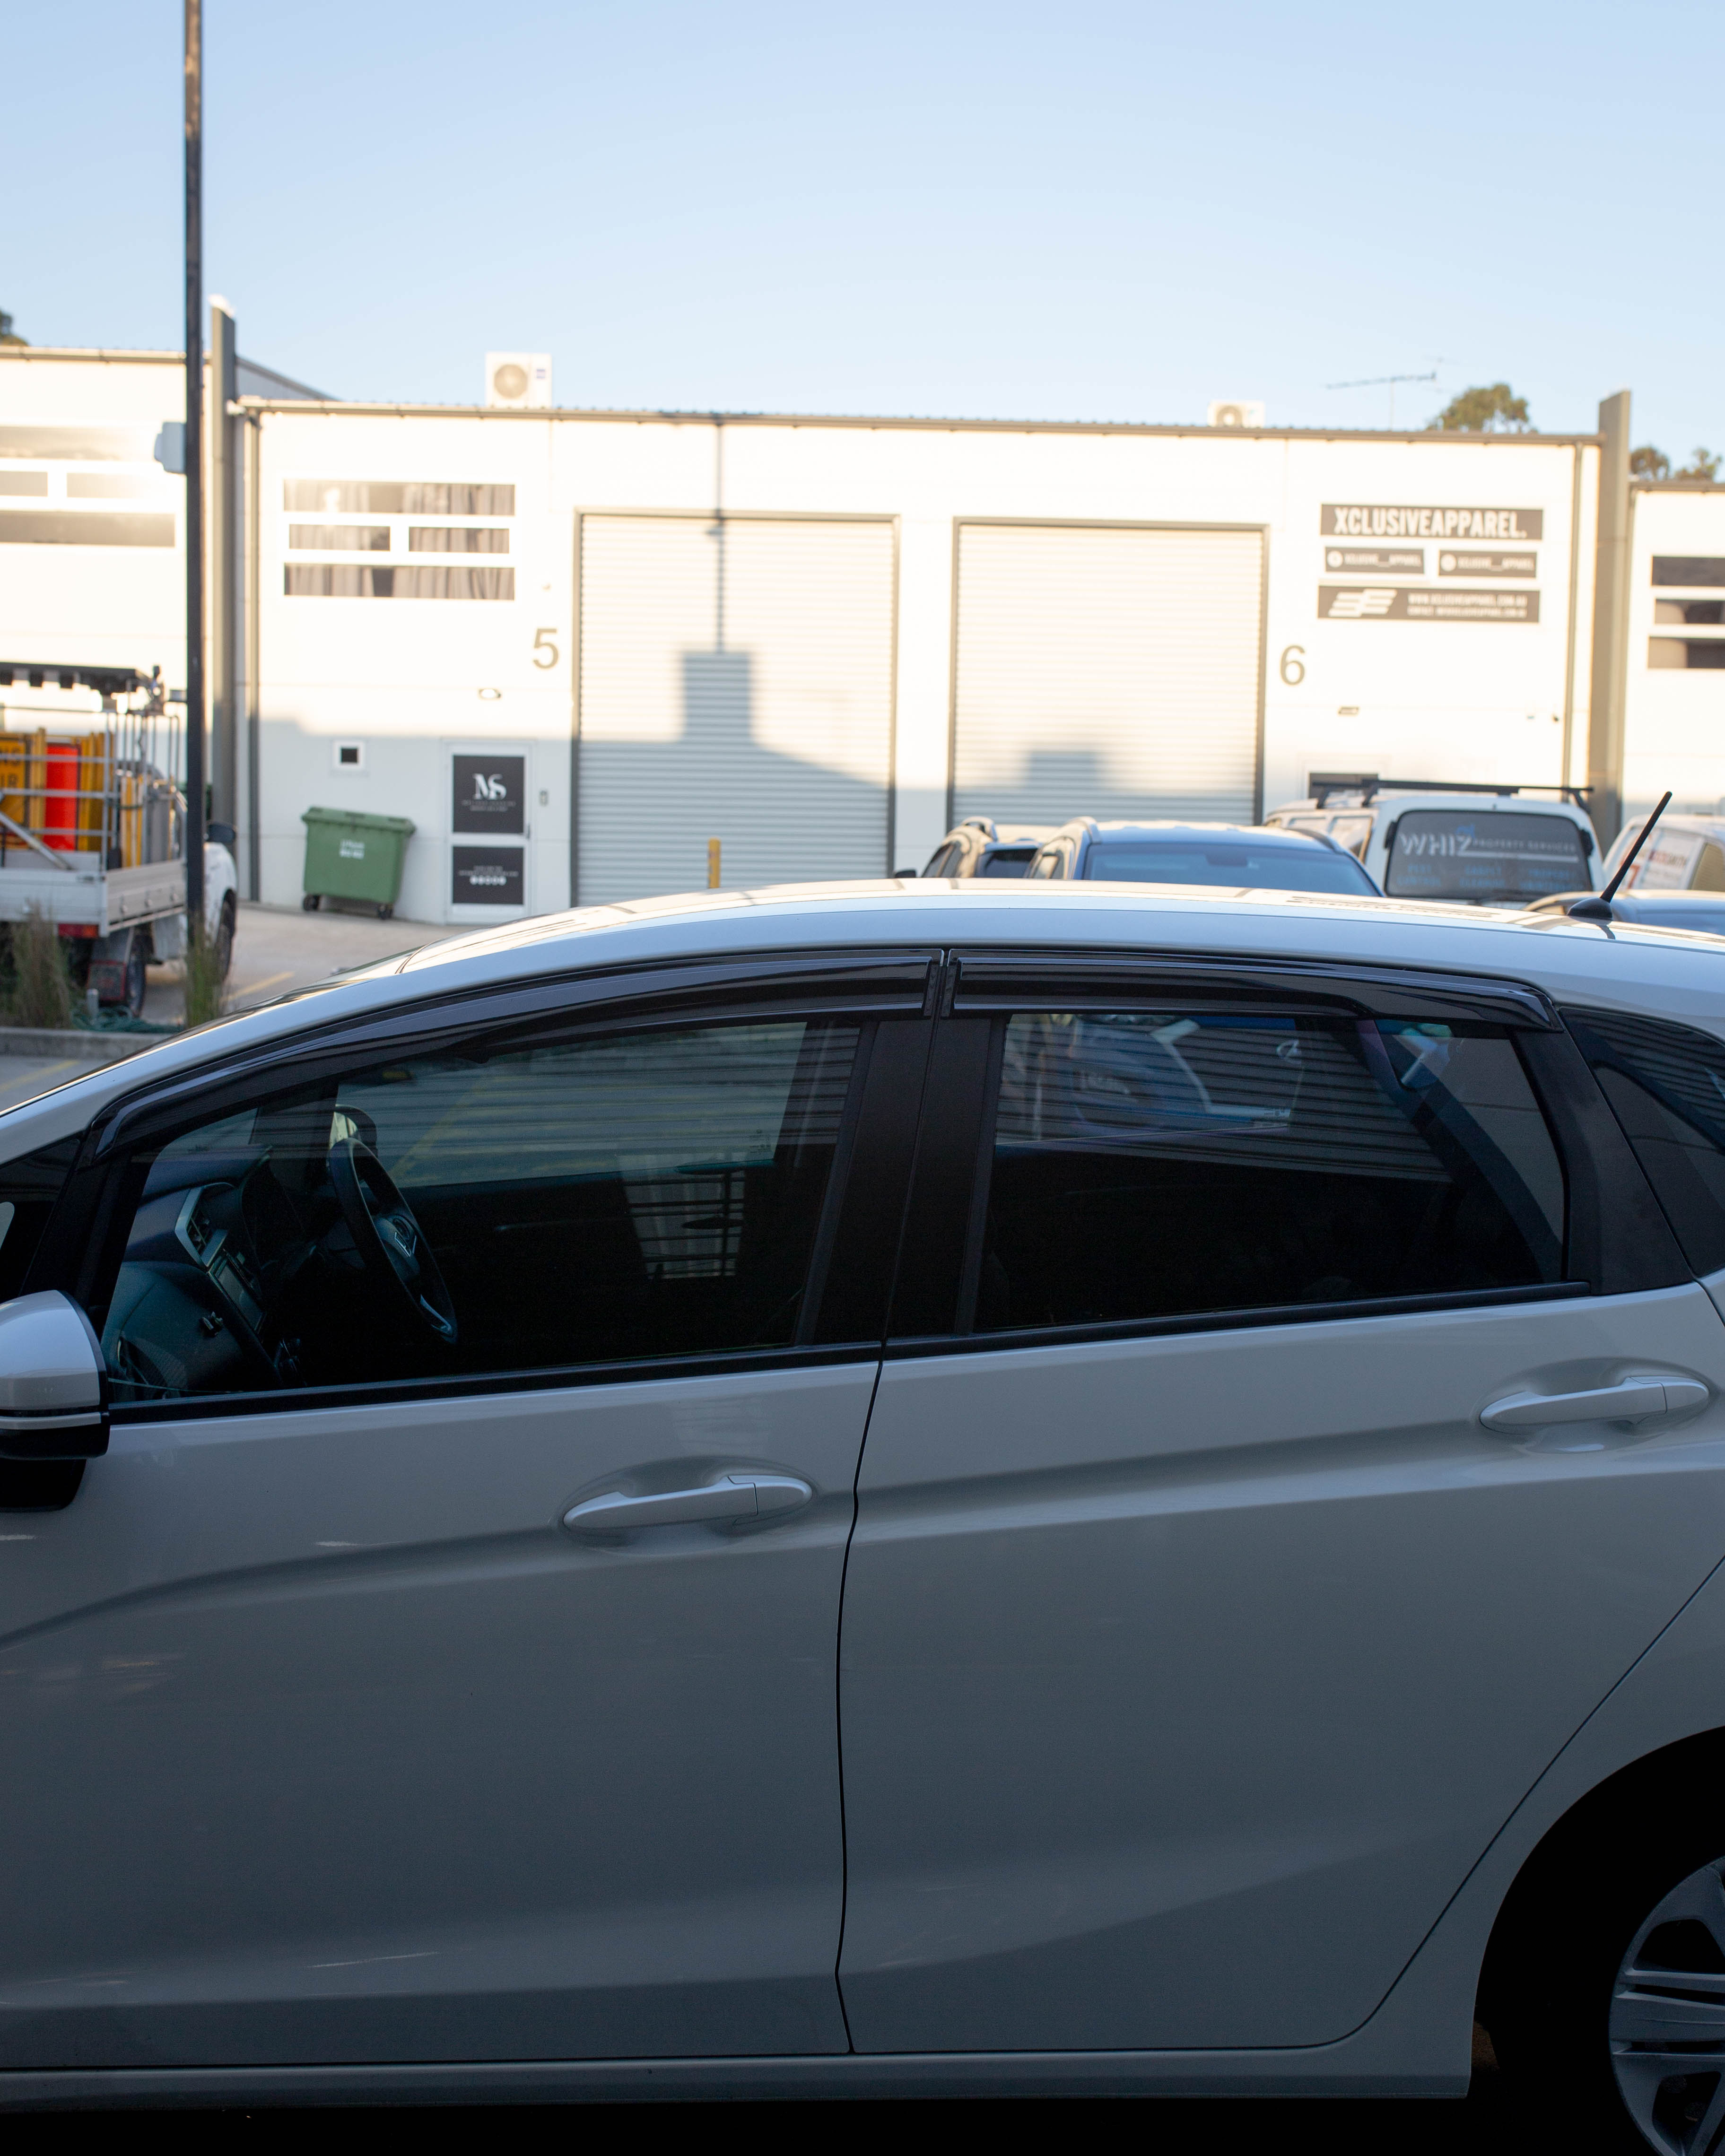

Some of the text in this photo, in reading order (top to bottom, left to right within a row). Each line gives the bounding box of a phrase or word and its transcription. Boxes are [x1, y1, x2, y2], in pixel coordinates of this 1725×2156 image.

[532, 628, 559, 669] 5
[1280, 644, 1306, 686] 6
[1398, 832, 1472, 856] WHIZ
